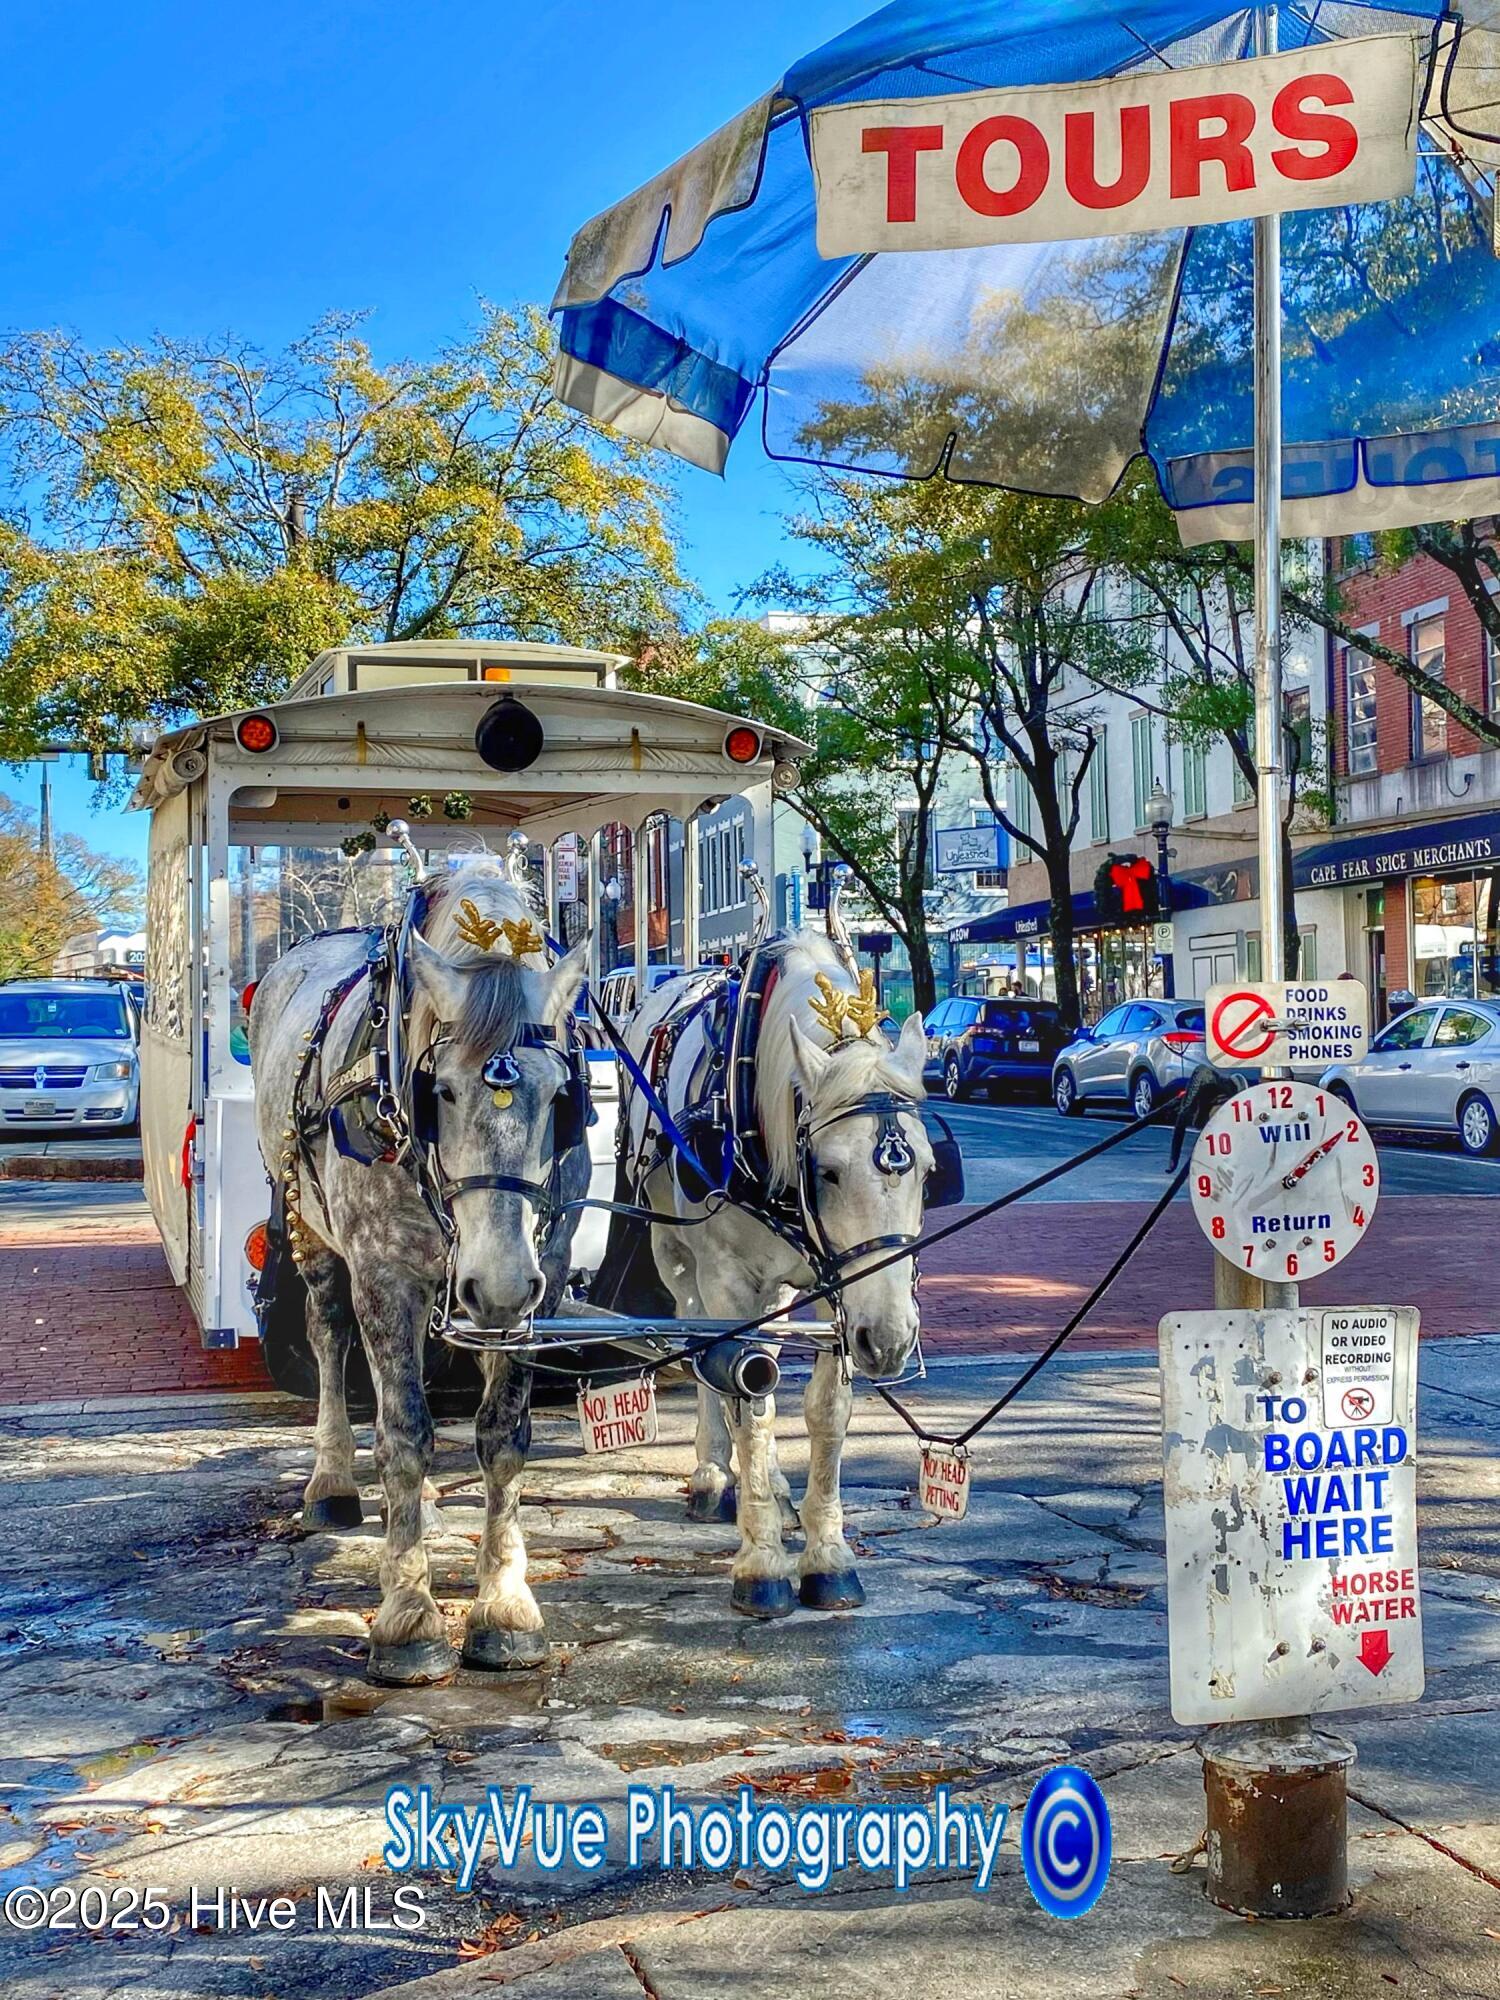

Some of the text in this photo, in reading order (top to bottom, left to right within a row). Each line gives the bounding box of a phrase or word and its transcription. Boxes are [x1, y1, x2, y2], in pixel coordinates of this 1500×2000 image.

[861, 73, 1359, 223] TOURS
[1310, 838, 1491, 884] CAPE FEAR SPICE MERCHANTS
[950, 928, 969, 942] MEOW
[1285, 988, 1328, 1003] FOOD
[1286, 1006, 1347, 1022] DRINKS
[1286, 1024, 1362, 1041] SMOKING
[1288, 1044, 1353, 1060] PHONES
[1267, 1086, 1293, 1109] 12
[1315, 1095, 1325, 1117] 1
[1231, 1100, 1252, 1123] 11
[1258, 1122, 1311, 1144] Will
[1346, 1119, 1359, 1143] 2
[1205, 1132, 1231, 1156] 10
[1198, 1175, 1211, 1198] 9
[1362, 1164, 1374, 1187] 3
[1211, 1216, 1225, 1239] 8
[1252, 1213, 1331, 1234] Return
[1353, 1205, 1365, 1228] 4
[1243, 1245, 1254, 1268] 7
[1323, 1239, 1336, 1262] 5
[1286, 1253, 1298, 1276] 6
[1331, 1318, 1388, 1330] NO AUDIO
[1331, 1335, 1386, 1347] OR VIDEO
[1325, 1352, 1391, 1365] RECORDING
[1327, 1374, 1389, 1384] EXPRESS PERMISSION
[583, 1387, 650, 1423] NO! HEAD
[1256, 1395, 1306, 1424] TO
[593, 1416, 645, 1449] PETTING
[1264, 1427, 1408, 1473] BOARD
[941, 1461, 966, 1485] HEAD
[926, 1485, 960, 1512] PETTING
[1283, 1471, 1390, 1516] WAIT
[1283, 1515, 1394, 1561] HERE
[1331, 1569, 1415, 1598] HORSE
[1331, 1597, 1416, 1626] WATER
